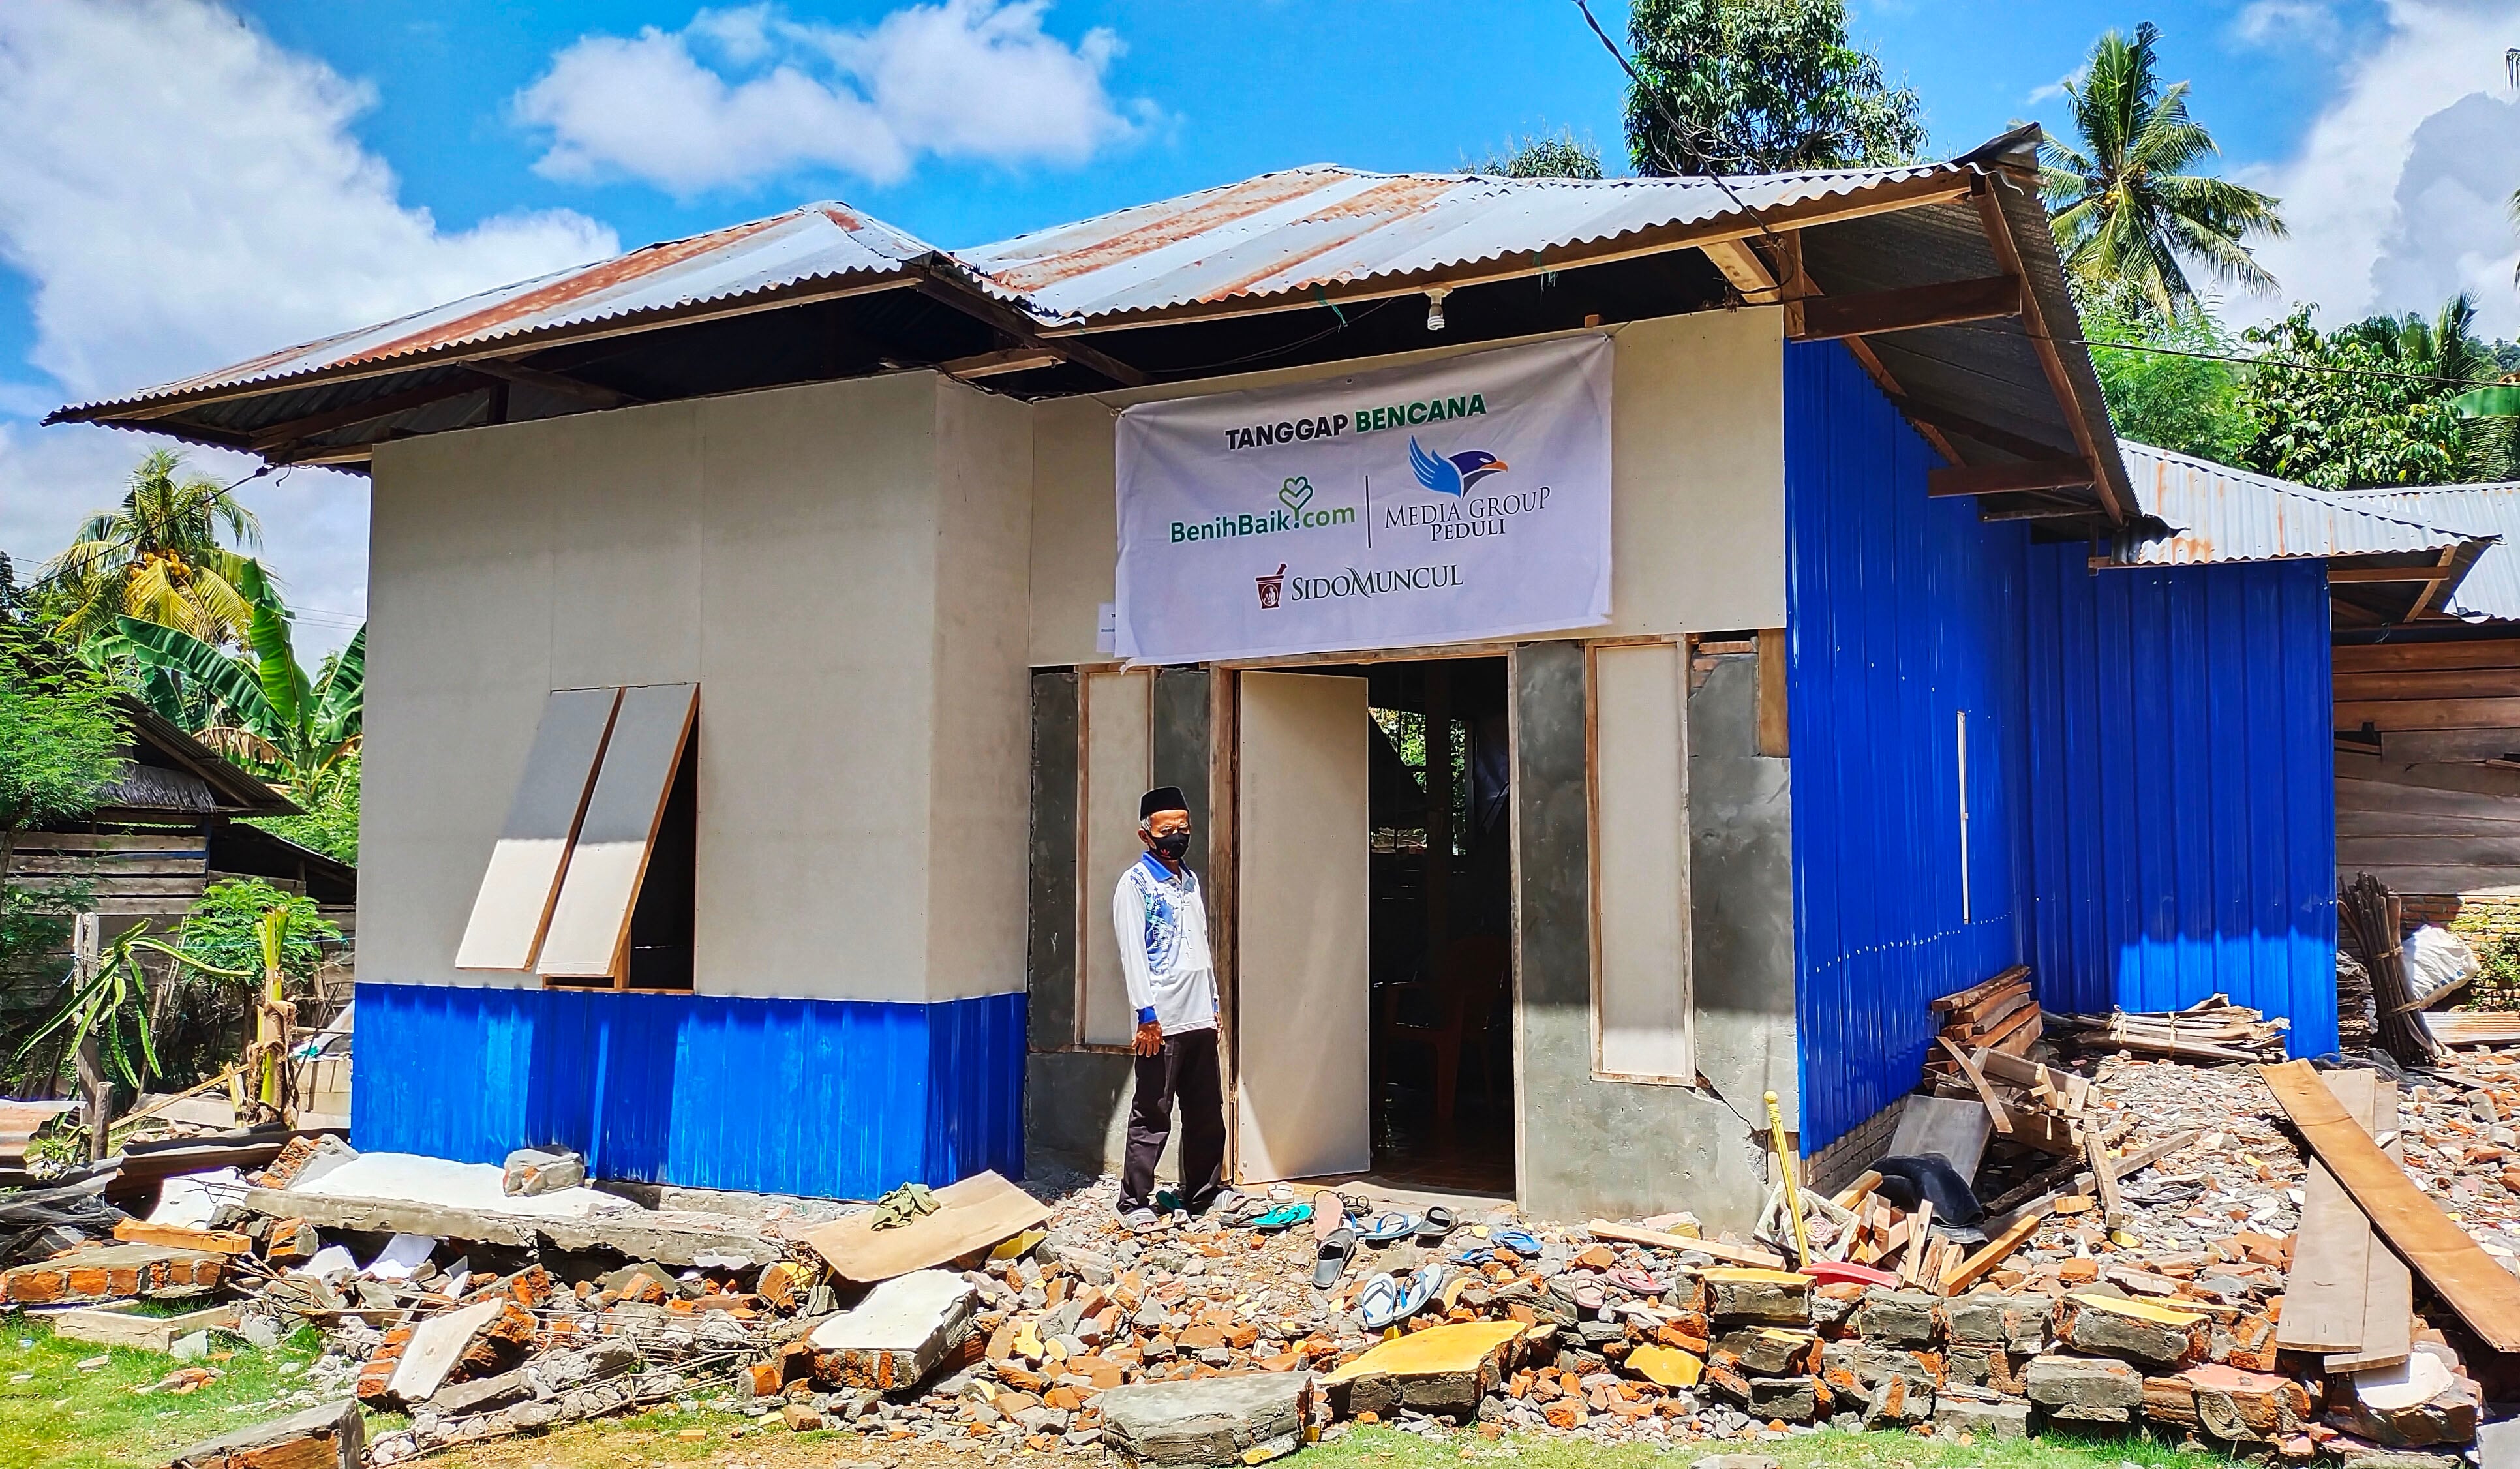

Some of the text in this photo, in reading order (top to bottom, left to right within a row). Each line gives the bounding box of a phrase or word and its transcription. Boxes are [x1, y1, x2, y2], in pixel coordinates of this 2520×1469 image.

[1225, 393, 1487, 450] TANGGAP BENCANA
[1384, 487, 1551, 528] MEDIA GROUP
[1431, 519, 1506, 541] PEDULI
